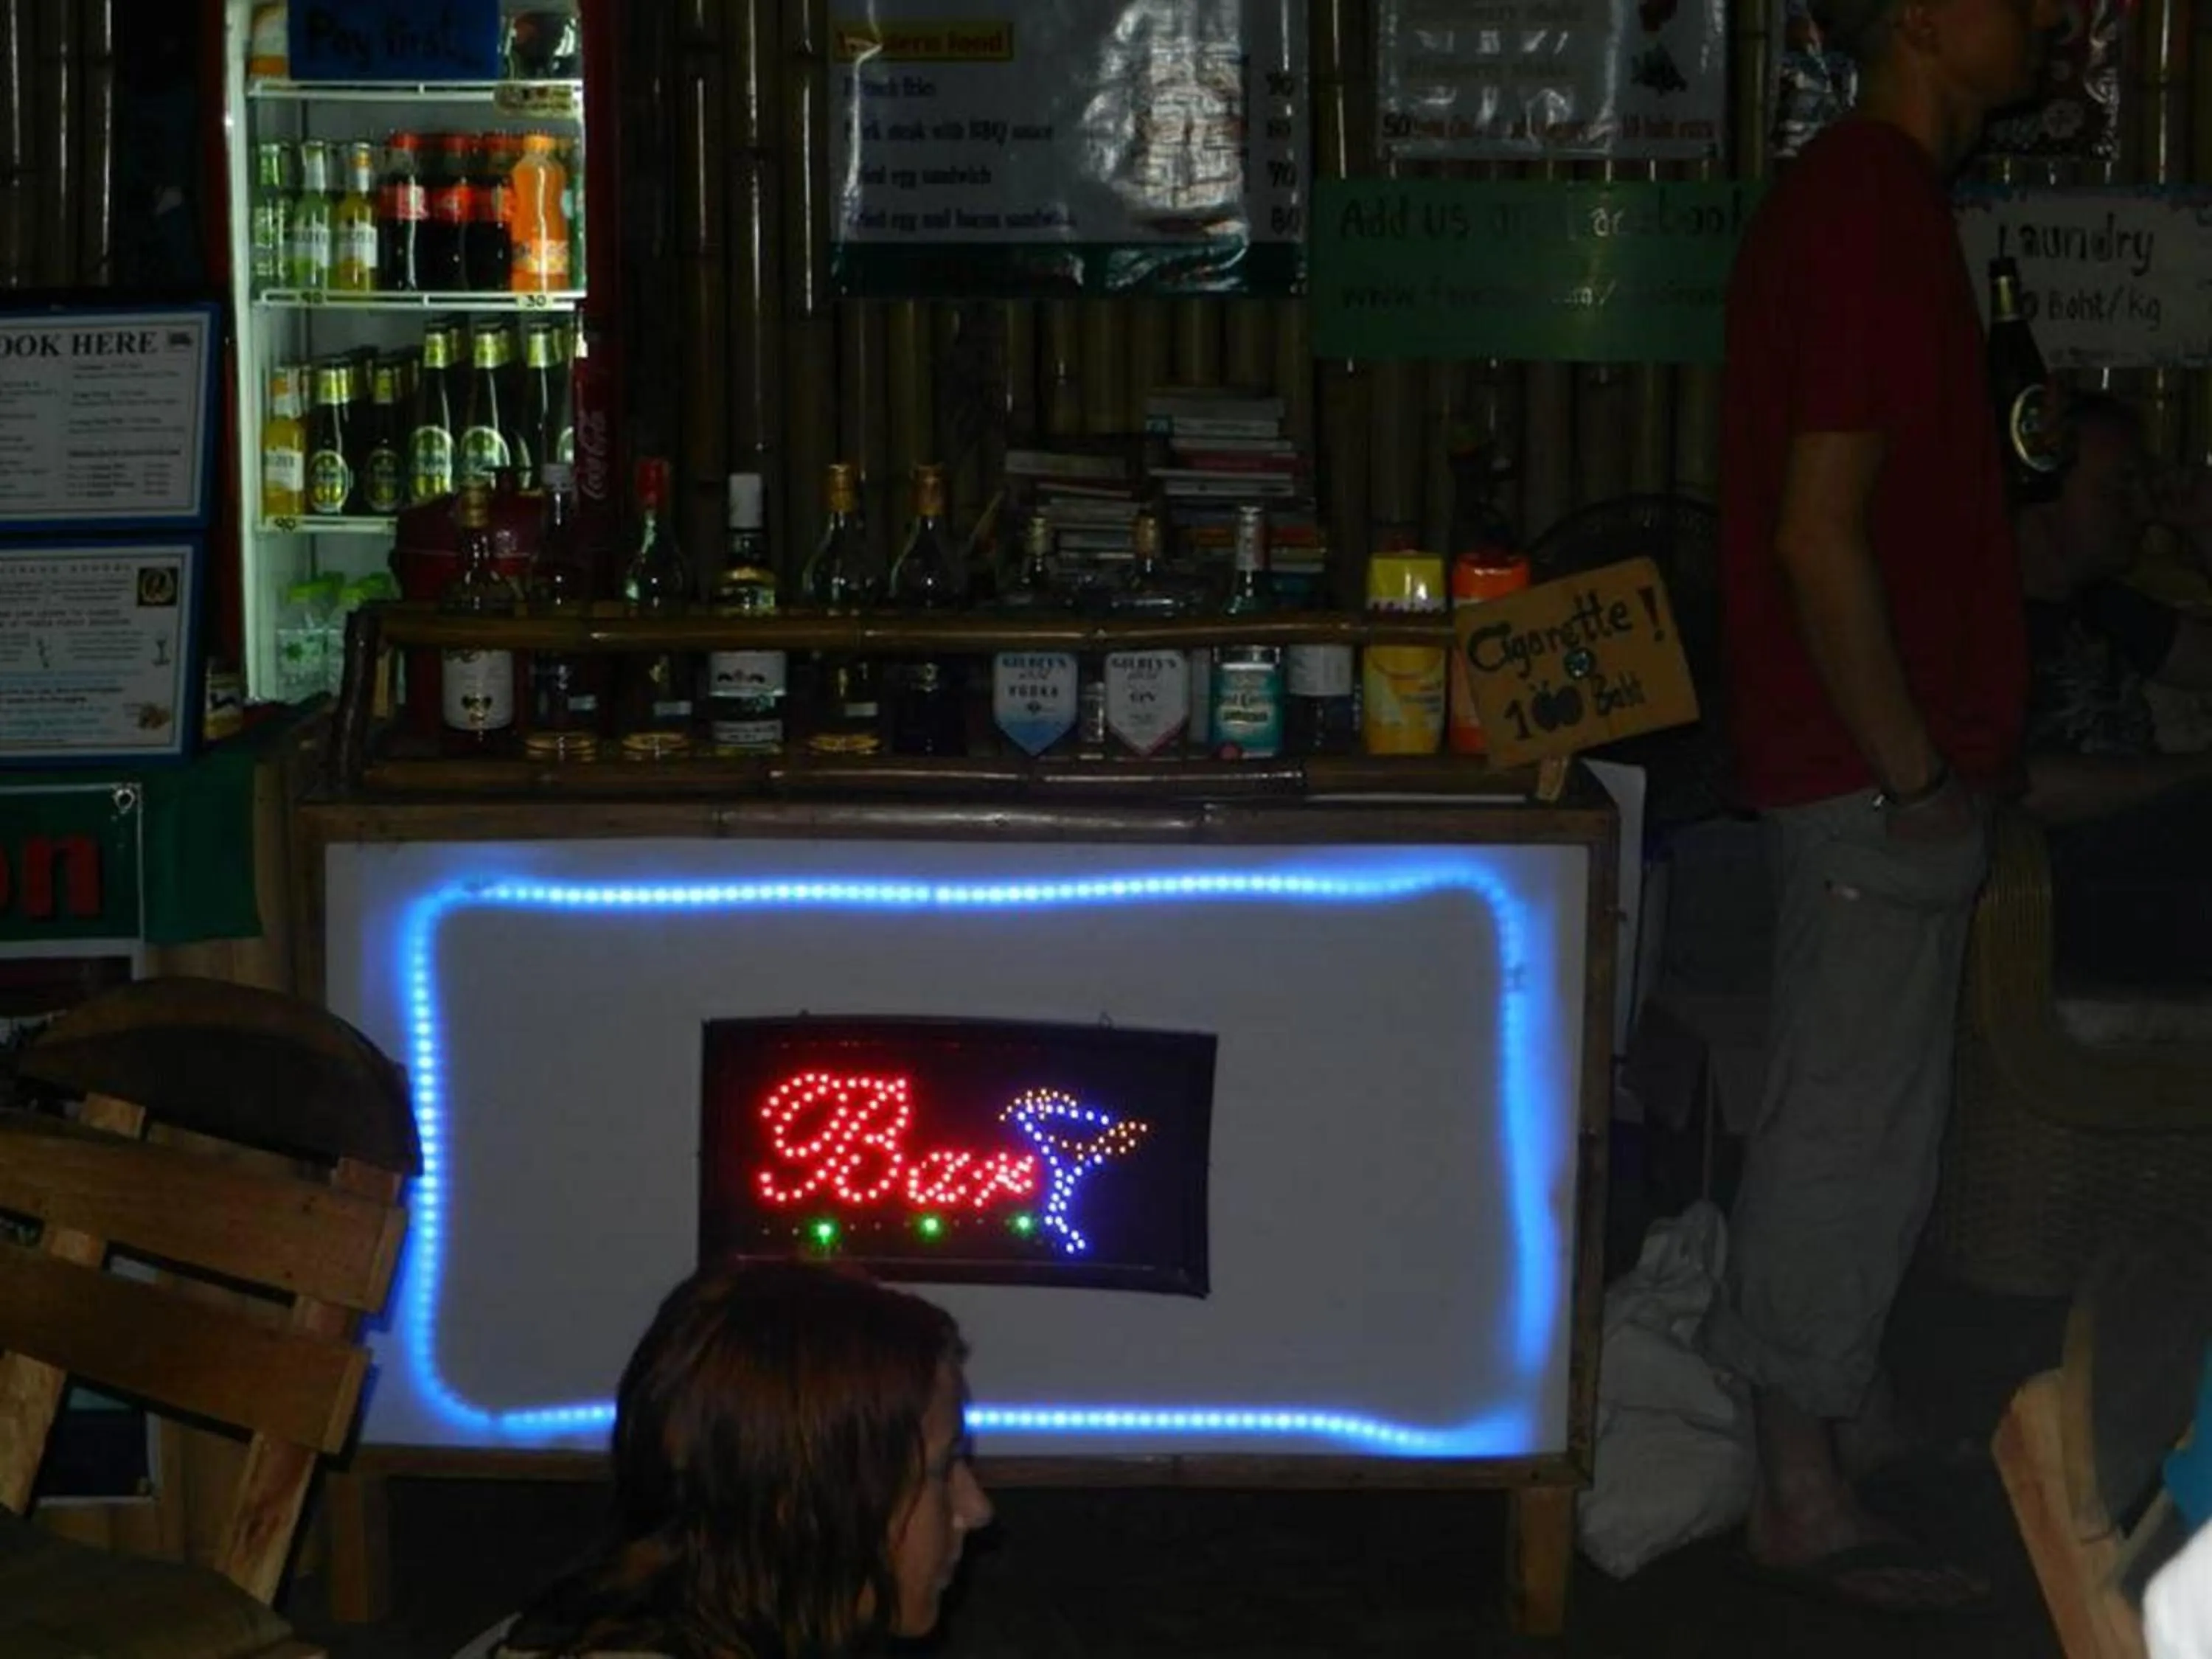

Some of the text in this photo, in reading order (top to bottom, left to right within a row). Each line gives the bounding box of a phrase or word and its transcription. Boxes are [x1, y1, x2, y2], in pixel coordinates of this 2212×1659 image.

[1339, 192, 1411, 240] Add
[1423, 201, 1471, 240] us
[72, 331, 159, 355] HERE
[1468, 591, 1634, 679] Cigarette
[0, 833, 102, 919] n
[757, 1071, 1035, 1209] Bar
